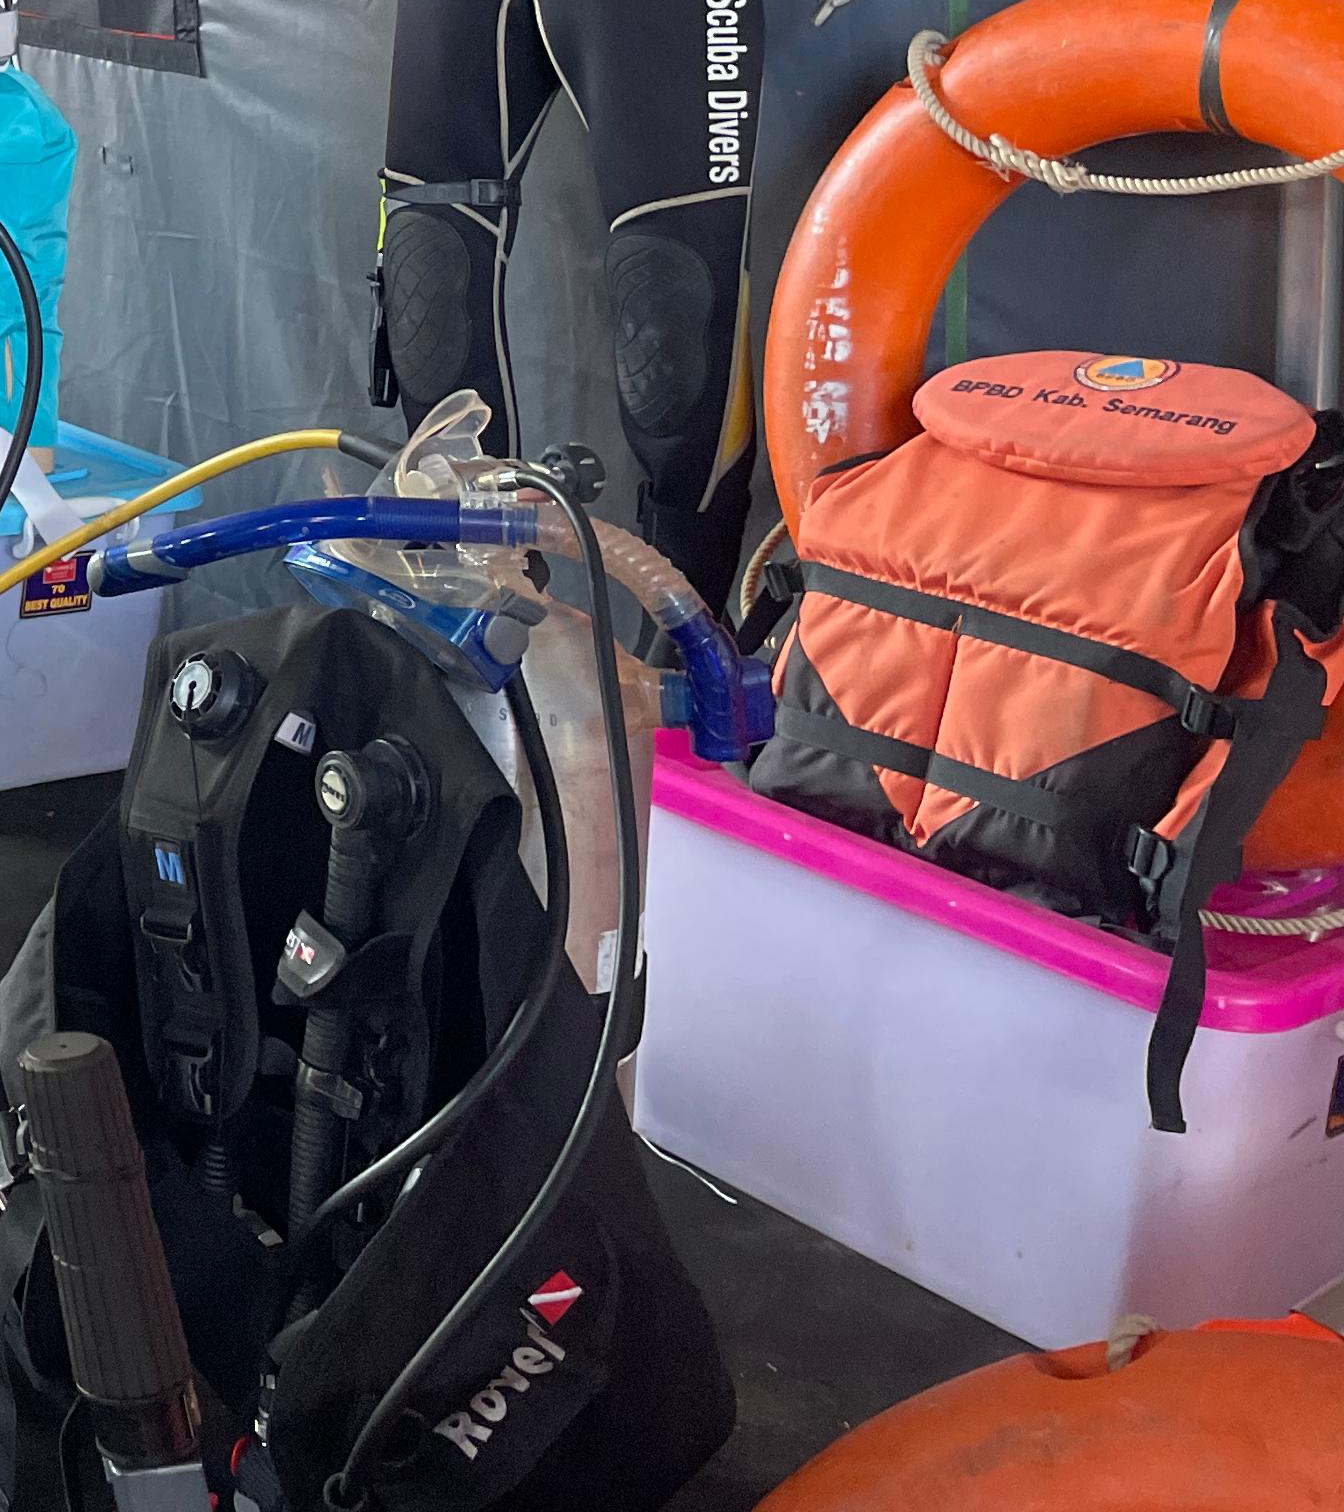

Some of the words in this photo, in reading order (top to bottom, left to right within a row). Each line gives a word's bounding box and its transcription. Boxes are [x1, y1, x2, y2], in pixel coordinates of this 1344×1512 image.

[707, 90, 749, 184] Divers
[951, 380, 1023, 399] BPBD
[1032, 389, 1088, 408] Kab.
[1103, 398, 1238, 436] Semarang
[24, 599, 49, 612] BEST
[50, 594, 88, 608] QUALITY
[292, 722, 312, 747] M
[155, 846, 185, 885] M
[432, 1322, 566, 1461] Rover
